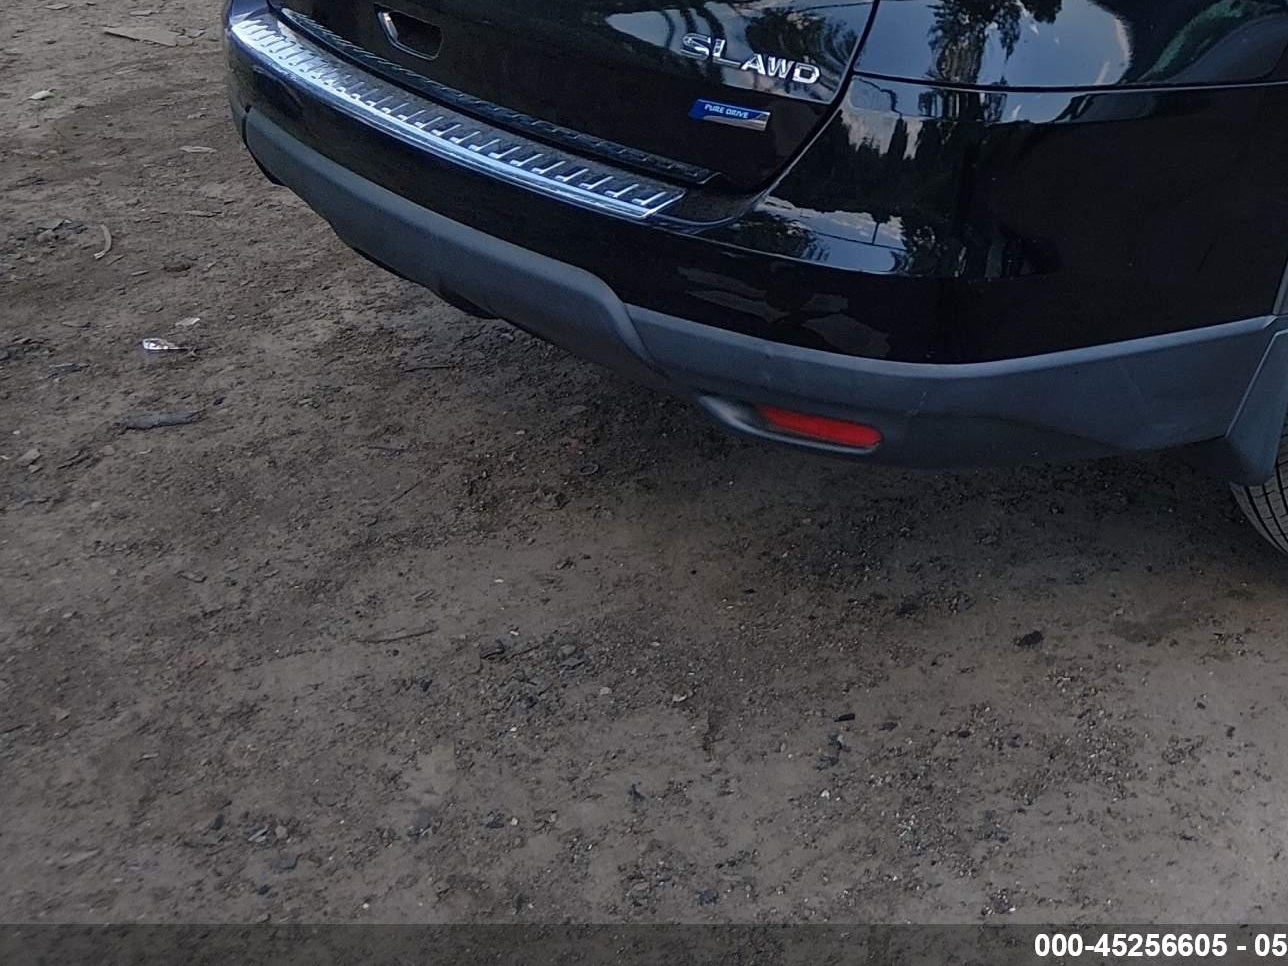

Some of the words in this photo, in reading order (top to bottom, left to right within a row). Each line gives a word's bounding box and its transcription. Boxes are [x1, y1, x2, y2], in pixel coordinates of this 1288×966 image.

[680, 32, 741, 67] SL
[741, 54, 819, 83] AWD
[704, 104, 725, 114] PURE
[725, 108, 749, 119] DRIVE
